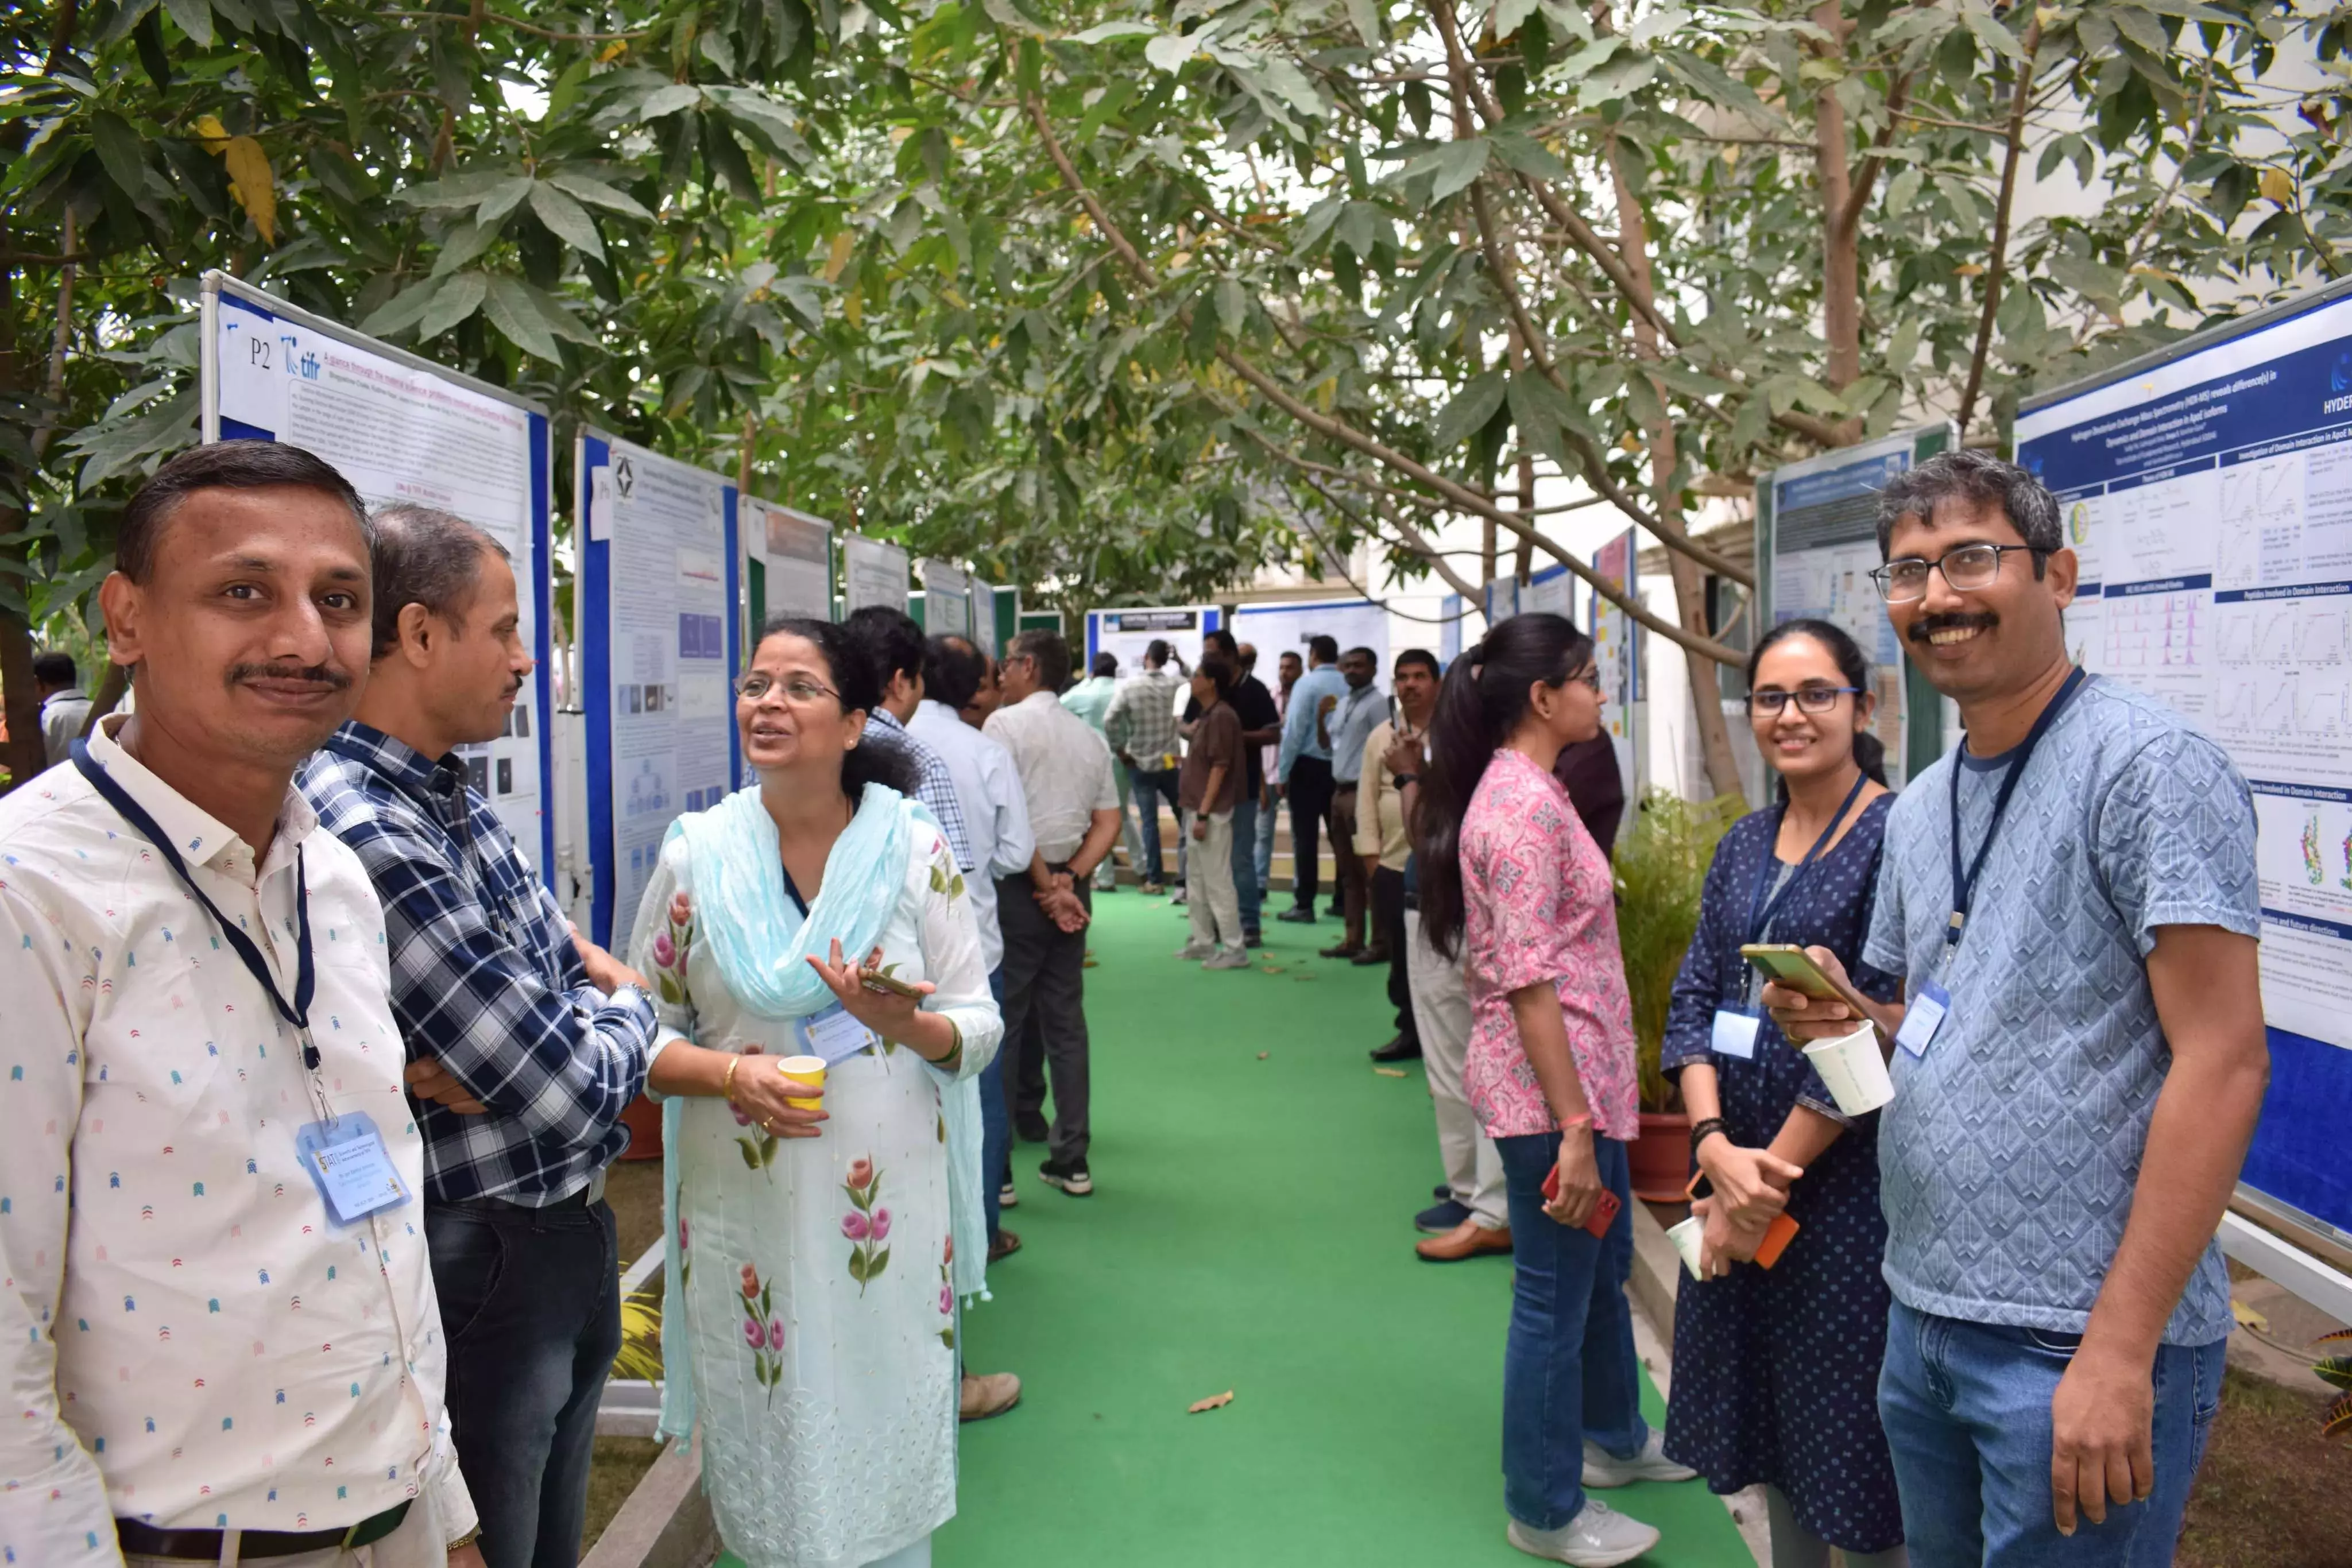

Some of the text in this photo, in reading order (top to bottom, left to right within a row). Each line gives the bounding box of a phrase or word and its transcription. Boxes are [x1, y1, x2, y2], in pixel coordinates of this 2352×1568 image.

[251, 337, 270, 369] P2
[301, 351, 320, 380] tifr
[2211, 384, 2232, 398] reveals
[2233, 370, 2269, 393] difference(s)
[2270, 370, 2277, 381] in
[2239, 446, 2268, 460] Investigation
[2269, 445, 2274, 454] of
[2274, 440, 2295, 452] Domain
[2295, 434, 2324, 447] Interaction
[2325, 432, 2331, 442] in
[2332, 428, 2347, 441] ApoE
[2244, 584, 2350, 601] Peptides Involved in Domain Interaction
[2261, 783, 2283, 793] Involved
[2284, 785, 2290, 795] in
[2291, 786, 2313, 797] Domain
[2314, 789, 2347, 800] Interaction
[2279, 919, 2289, 927] and
[2291, 919, 2308, 931] future
[2310, 923, 2339, 937] directions
[319, 1153, 337, 1170] STAT
